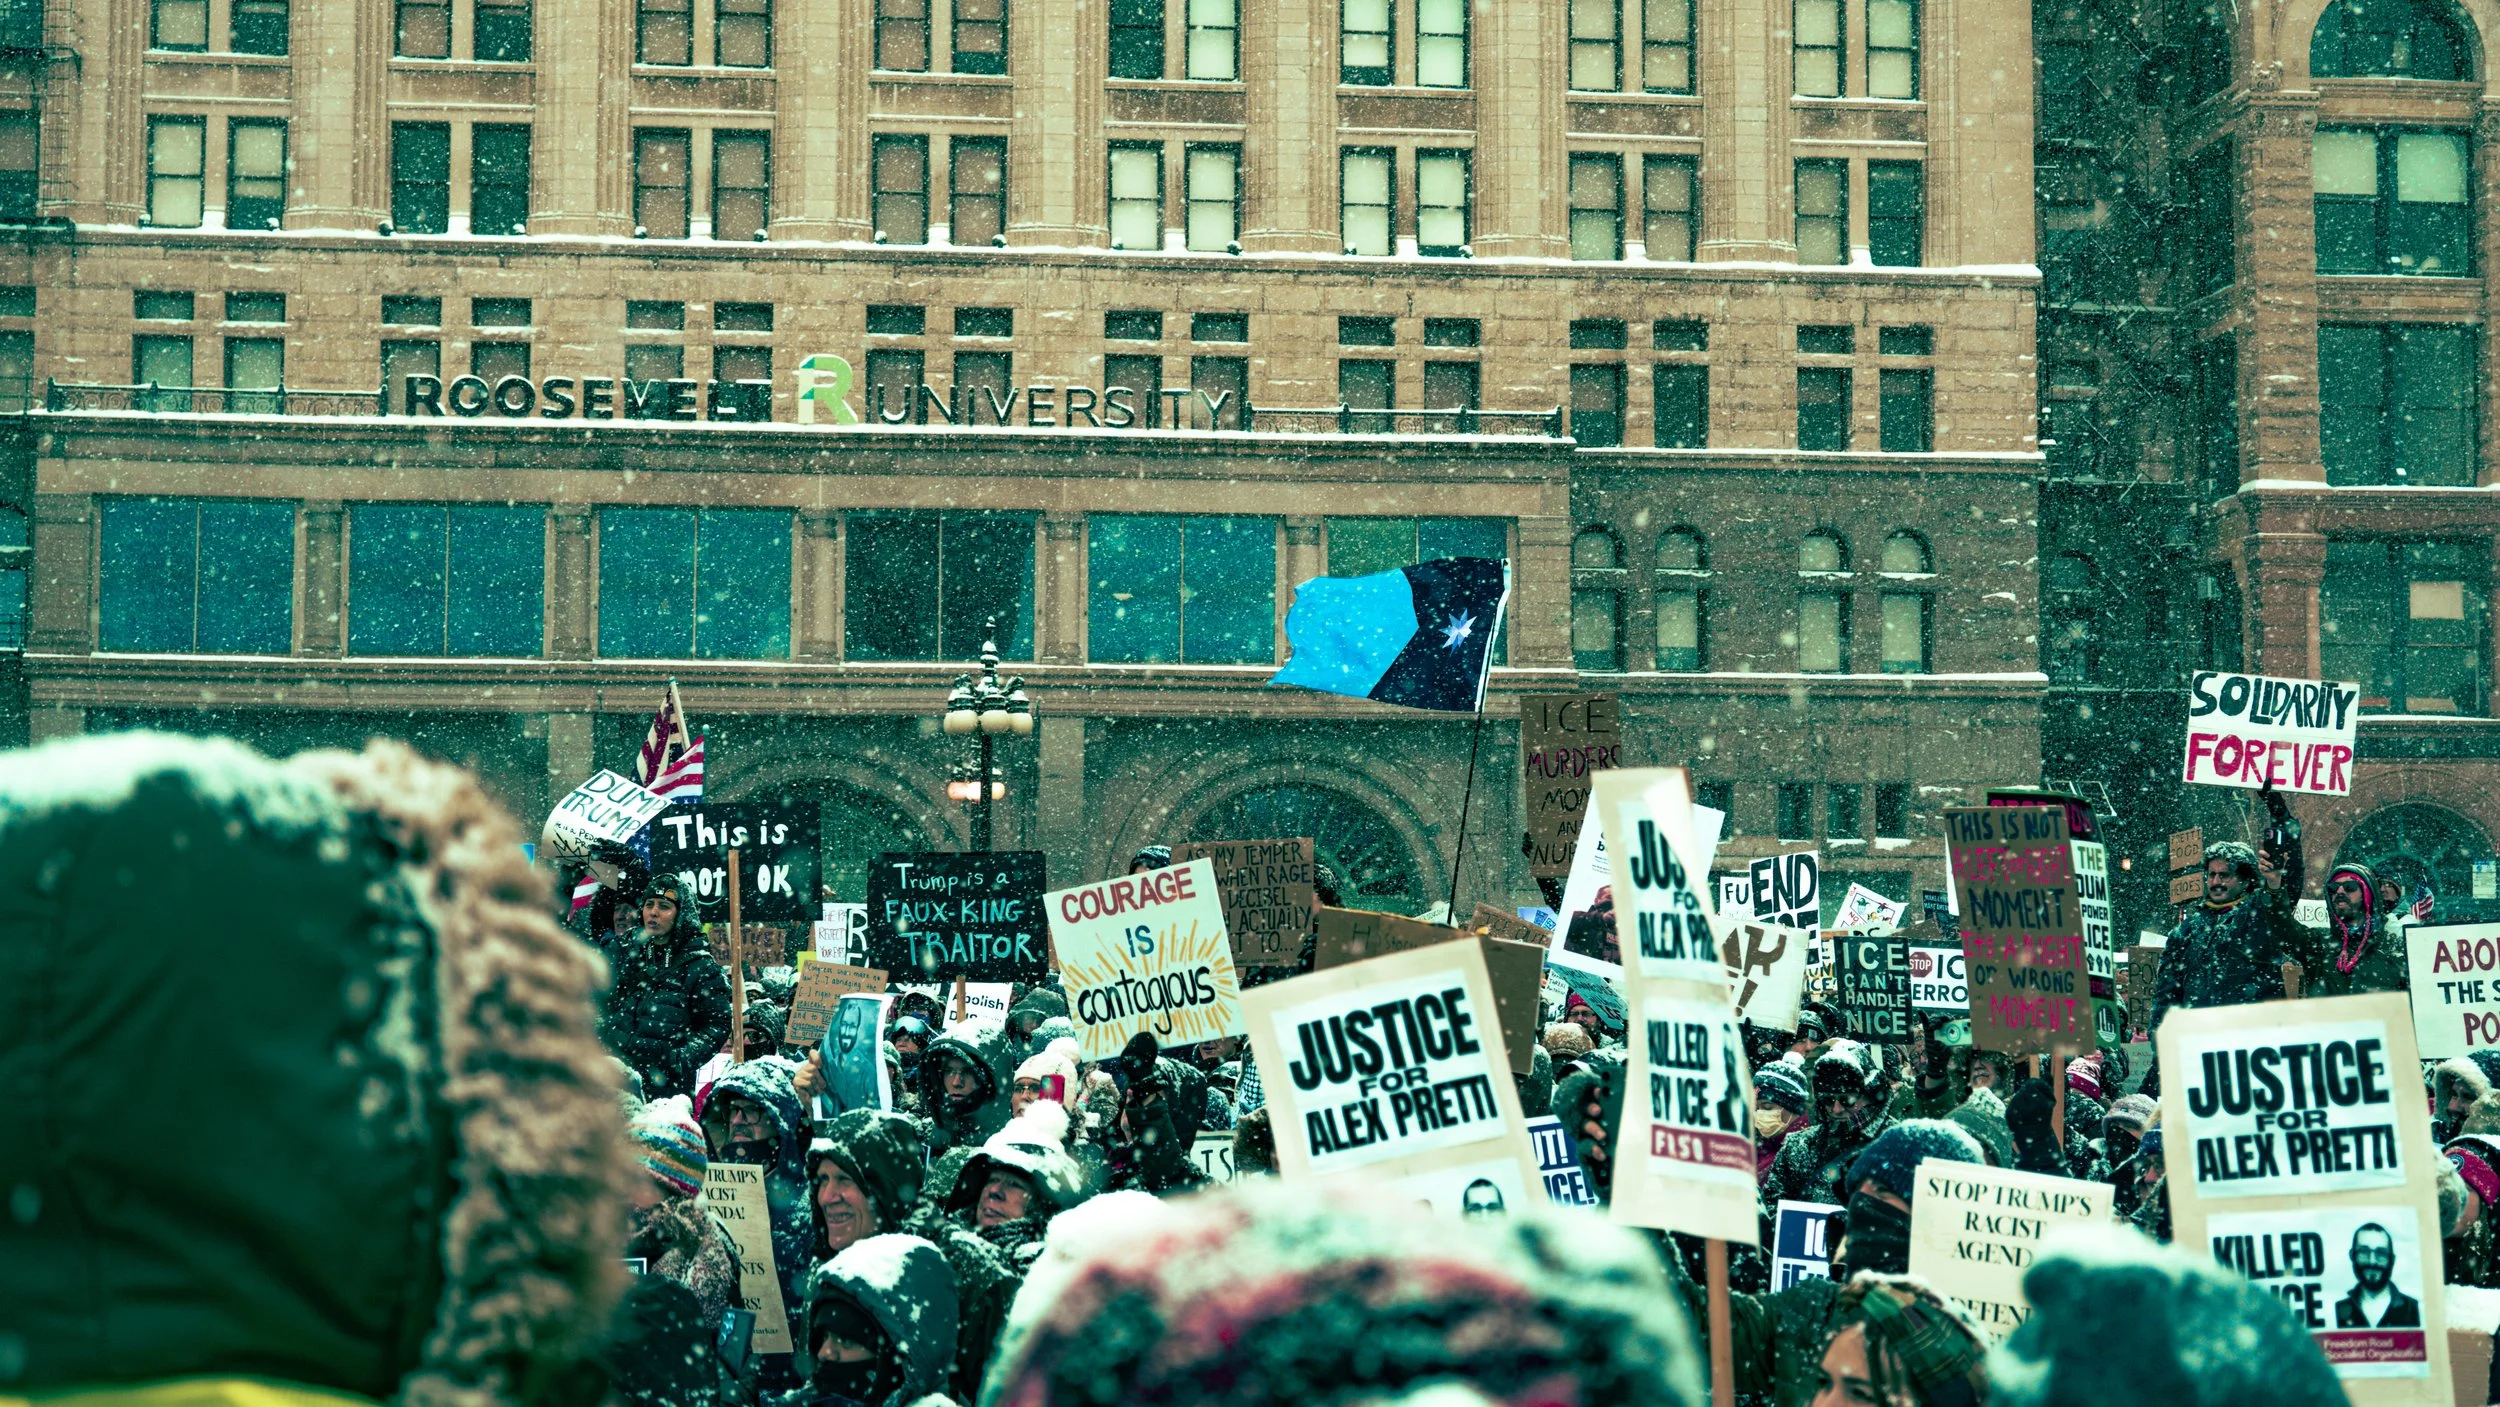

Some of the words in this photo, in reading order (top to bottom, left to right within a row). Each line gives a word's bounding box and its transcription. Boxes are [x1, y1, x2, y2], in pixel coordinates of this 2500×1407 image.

[404, 373, 772, 422] ROOSEVELT
[876, 384, 1233, 431] UNIVERSITY
[1543, 699, 1610, 733] ICE
[2190, 672, 2356, 730] SOLIDARITY
[2186, 733, 2352, 792] FOREVER
[583, 772, 668, 815] DUMP
[561, 790, 642, 839] TRUMP
[661, 812, 749, 850] This
[759, 819, 790, 846] is
[1557, 820, 1584, 837] AN
[1945, 811, 1994, 842] THIS
[2001, 812, 2020, 841] IS
[2023, 811, 2063, 841] NOT
[1214, 846, 1236, 867] MY
[1243, 842, 1304, 867] TEMPER
[2077, 846, 2105, 871] THE
[679, 866, 727, 897] not
[757, 863, 794, 898] OK
[892, 863, 959, 897] Trump
[966, 872, 984, 887] is
[995, 872, 1010, 885] a
[1214, 865, 1259, 887] WHEN
[1266, 863, 1313, 886] RAGE
[1751, 853, 1818, 917] END
[885, 899, 1024, 925] FAUX-KING
[1061, 867, 1196, 924] COURAGE
[1228, 886, 1292, 909] DECIBEL
[1967, 887, 2065, 929] MOMENT
[2082, 904, 2109, 921] POWER
[2291, 905, 2329, 923] ABO
[899, 930, 1037, 966] TRAITOR
[1125, 924, 1155, 958] IS
[1638, 911, 1686, 960] ALEX
[2003, 934, 2018, 961] A
[2085, 924, 2110, 951] ICE
[1842, 941, 1905, 972] ICE
[1909, 958, 1932, 971] STOP
[1936, 954, 1966, 980] IC
[2433, 936, 2500, 974] ABO
[831, 978, 862, 992] abridging
[1844, 972, 1905, 992] CAN'T
[1912, 983, 1969, 1003] ERRO
[1974, 963, 1998, 987] or
[2008, 966, 2075, 995] WRONG
[2437, 979, 2486, 1005] THE
[1077, 966, 1216, 1036] contagious
[1845, 990, 1907, 1009] HANDLE
[1990, 993, 2077, 1035] MOMENT
[2128, 997, 2150, 1025] PE
[1289, 987, 1480, 1091] JUSTICE
[1846, 1009, 1908, 1036] NICE
[2463, 1011, 2500, 1047] PO
[1647, 1019, 1710, 1071] KILLED
[1358, 1067, 1430, 1098] FOR
[2188, 1038, 2390, 1119] JUSTICE
[1305, 1097, 1389, 1157] ALEX
[1389, 1073, 1498, 1138] PRETTI
[1650, 1072, 1672, 1121] BY
[1676, 1076, 1712, 1127] ICE
[2255, 1109, 2329, 1132] FOR
[1530, 1129, 1569, 1167] UT!
[2197, 1132, 2280, 1183] ALEX
[2286, 1123, 2398, 1176] PRETTI
[708, 1168, 758, 1184] TRUMP'S
[1543, 1170, 1596, 1206] ICE!
[705, 1187, 737, 1202] ACIST
[1927, 1176, 1988, 1204] STOP
[1993, 1185, 2093, 1217] TRUMP'S
[707, 1205, 745, 1220] ENDA!
[1964, 1211, 2047, 1240] RACIST
[1951, 1240, 2034, 1269] AGEND
[2212, 1231, 2325, 1279] KILLED
